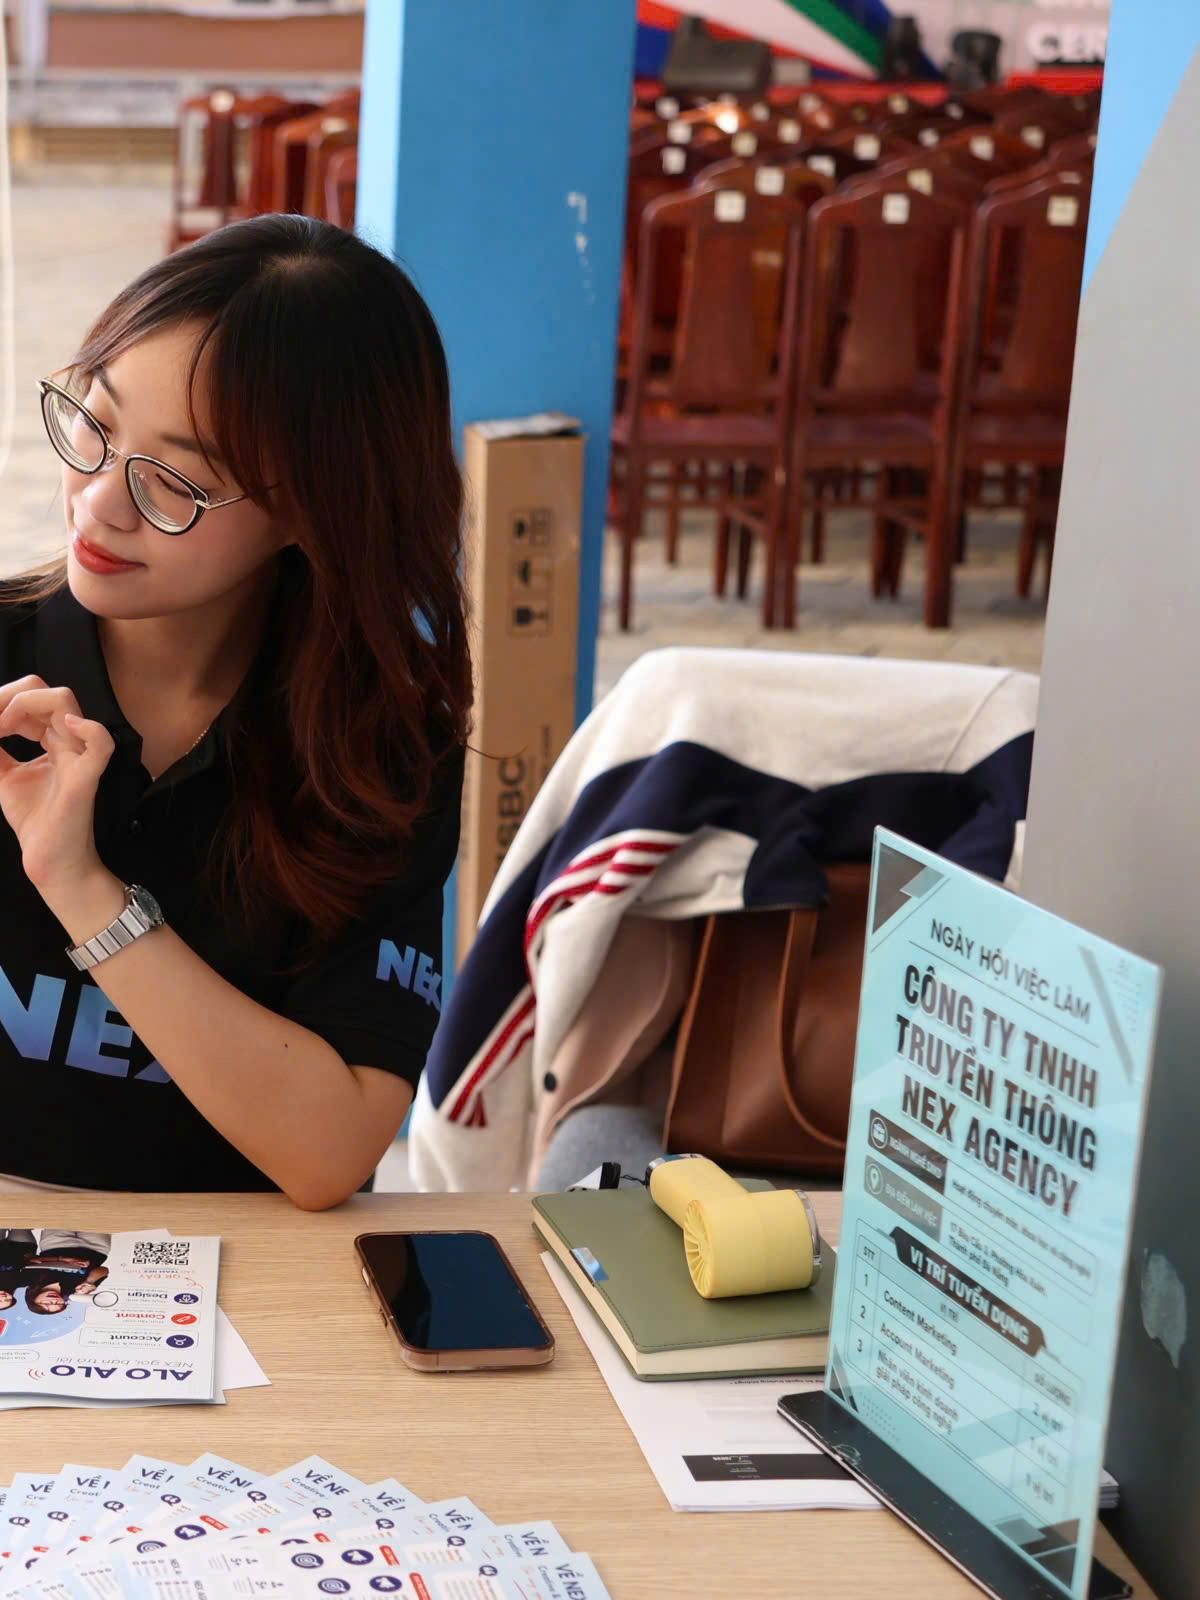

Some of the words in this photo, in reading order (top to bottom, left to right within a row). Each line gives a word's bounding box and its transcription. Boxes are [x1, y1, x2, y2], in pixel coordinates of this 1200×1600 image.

[931, 918, 975, 961] NGÀY
[979, 945, 1009, 982] HỘI
[1014, 965, 1050, 1003] VIỆC
[1054, 987, 1091, 1026] LÀM
[903, 962, 976, 1040] CÔNG
[982, 1006, 1017, 1060] TY
[1023, 1030, 1099, 1110] TNHH
[895, 1012, 995, 1111] TRUYỀN
[1003, 1077, 1098, 1172] THÔNG
[901, 1073, 958, 1144] NEX
[963, 1115, 1080, 1218] AGENCY
[863, 1245, 876, 1261] STT
[114, 1312, 166, 1320] Content
[127, 1291, 168, 1299] Design
[864, 1273, 870, 1288] 1
[883, 1290, 916, 1322] Content
[917, 1314, 958, 1357] Marketing
[910, 1245, 924, 1274] VỊ
[925, 1255, 947, 1286] TRÍ
[948, 1273, 991, 1318] TUYỂN
[991, 1303, 1030, 1346] DỤNG
[109, 1333, 162, 1342] Account
[857, 1338, 864, 1353] 3
[860, 1304, 867, 1320] 2
[880, 1323, 913, 1356] Account
[914, 1348, 955, 1390] Marketing
[50, 1364, 117, 1379] ALO
[126, 1367, 194, 1381] ALO
